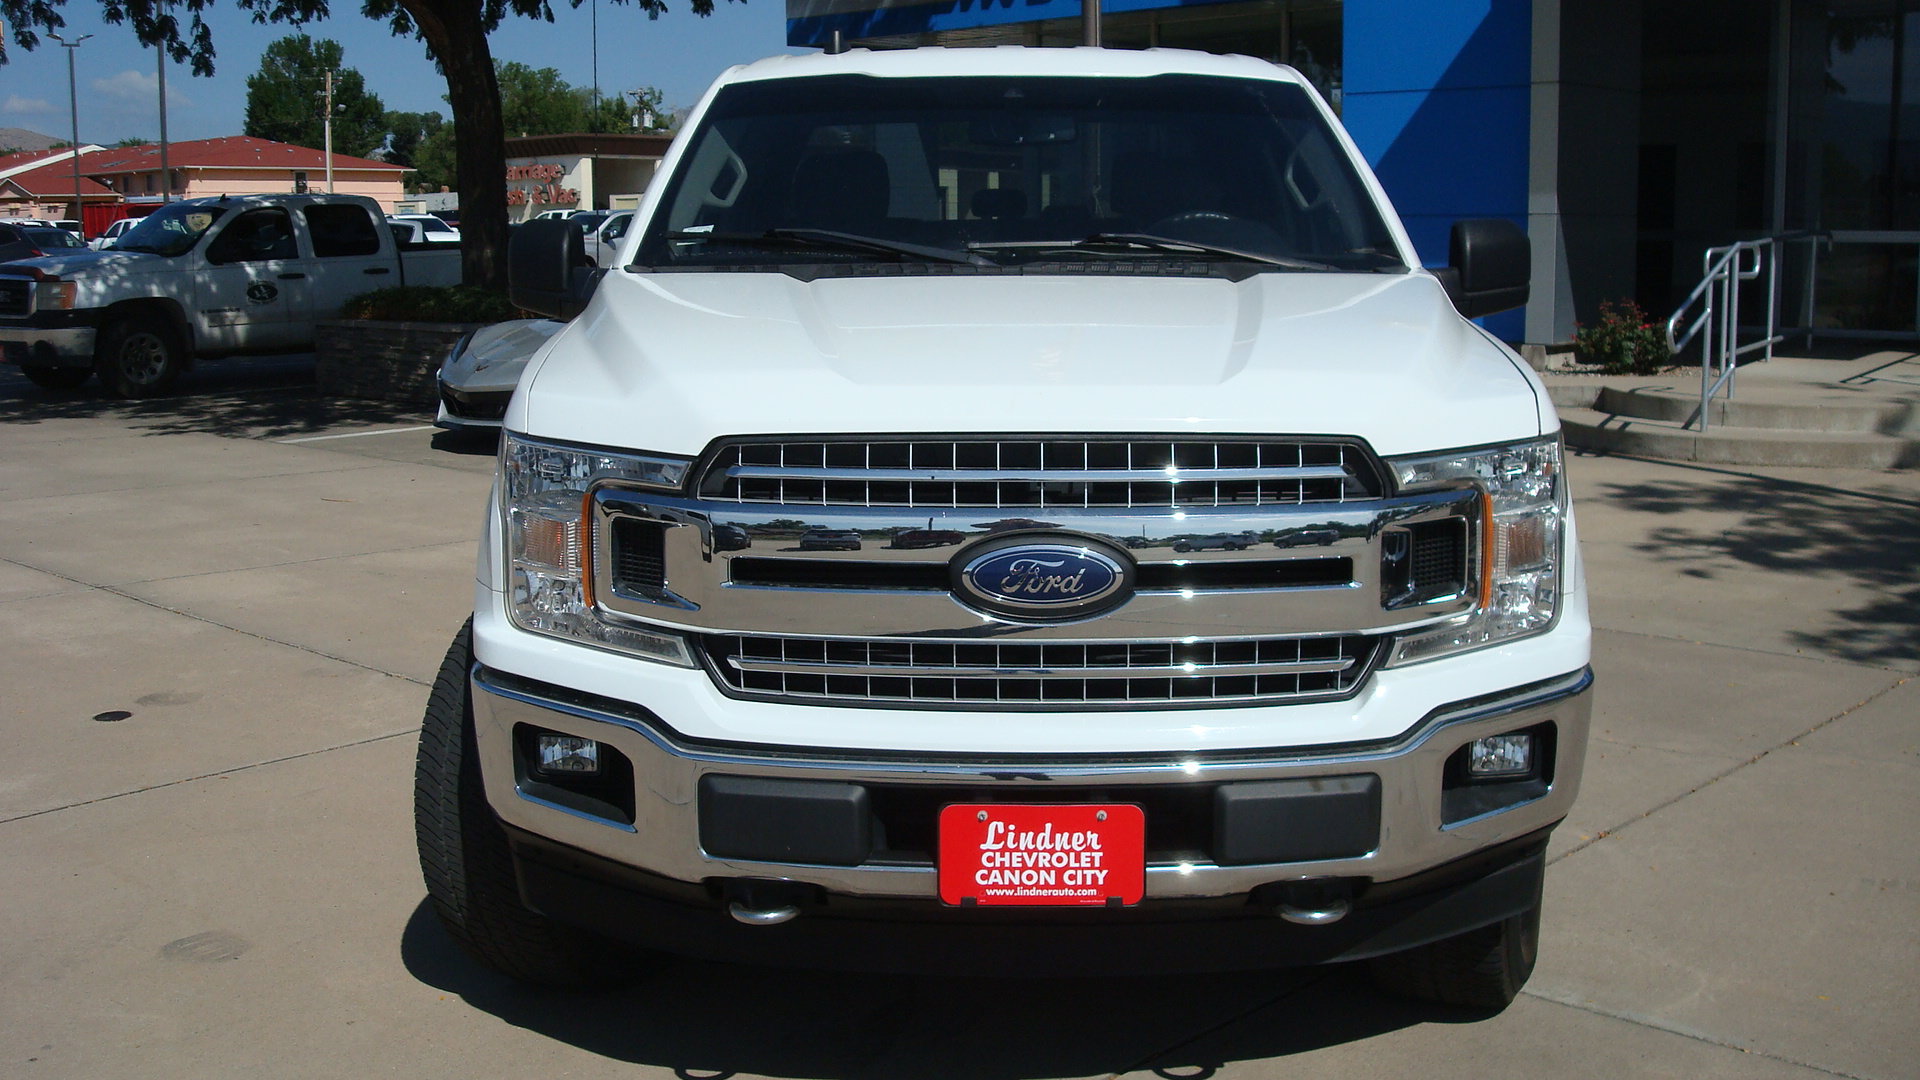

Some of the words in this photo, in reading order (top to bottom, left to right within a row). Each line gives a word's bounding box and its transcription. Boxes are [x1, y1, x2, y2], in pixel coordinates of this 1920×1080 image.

[506, 161, 562, 183] arriage
[506, 186, 525, 205] sh
[532, 184, 546, 204] &
[547, 184, 578, 204] Vac
[1000, 559, 1086, 594] Ford
[980, 821, 1102, 852] Lindner
[981, 851, 1104, 868] CHEVROLET
[975, 869, 1060, 886] CANON
[1062, 869, 1109, 886] CITY
[985, 886, 1097, 897] www.lindnerauto.com
